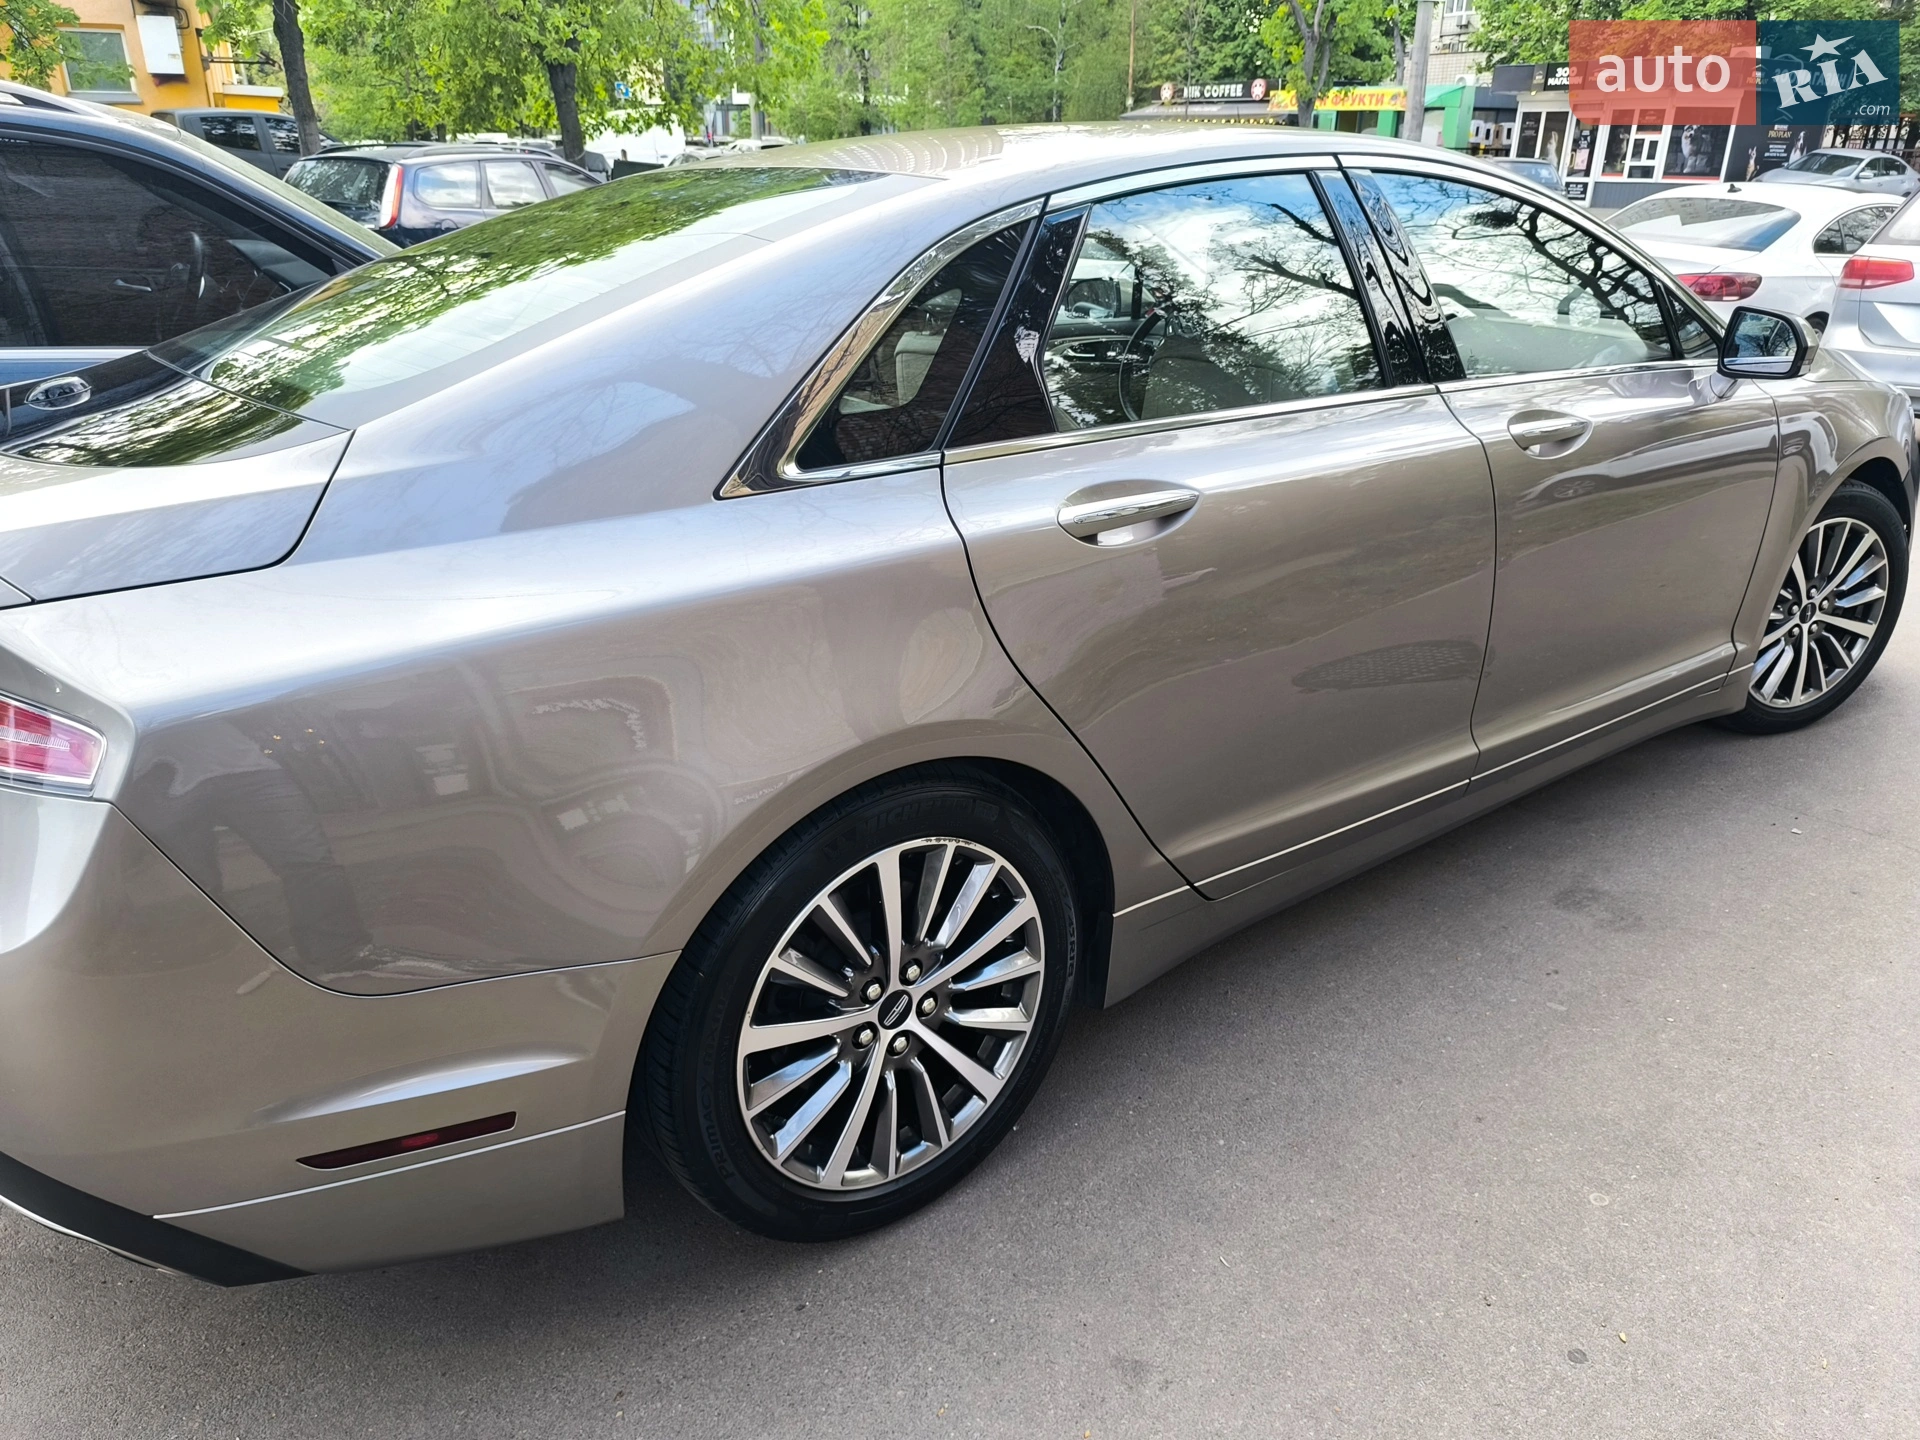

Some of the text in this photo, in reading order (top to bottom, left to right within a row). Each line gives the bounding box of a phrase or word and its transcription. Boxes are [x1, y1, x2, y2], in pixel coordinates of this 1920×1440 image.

[1203, 83, 1243, 98] COFFEE
[1331, 92, 1385, 107] ФРУКТИ
[700, 1077, 737, 1181] PRIMACY
